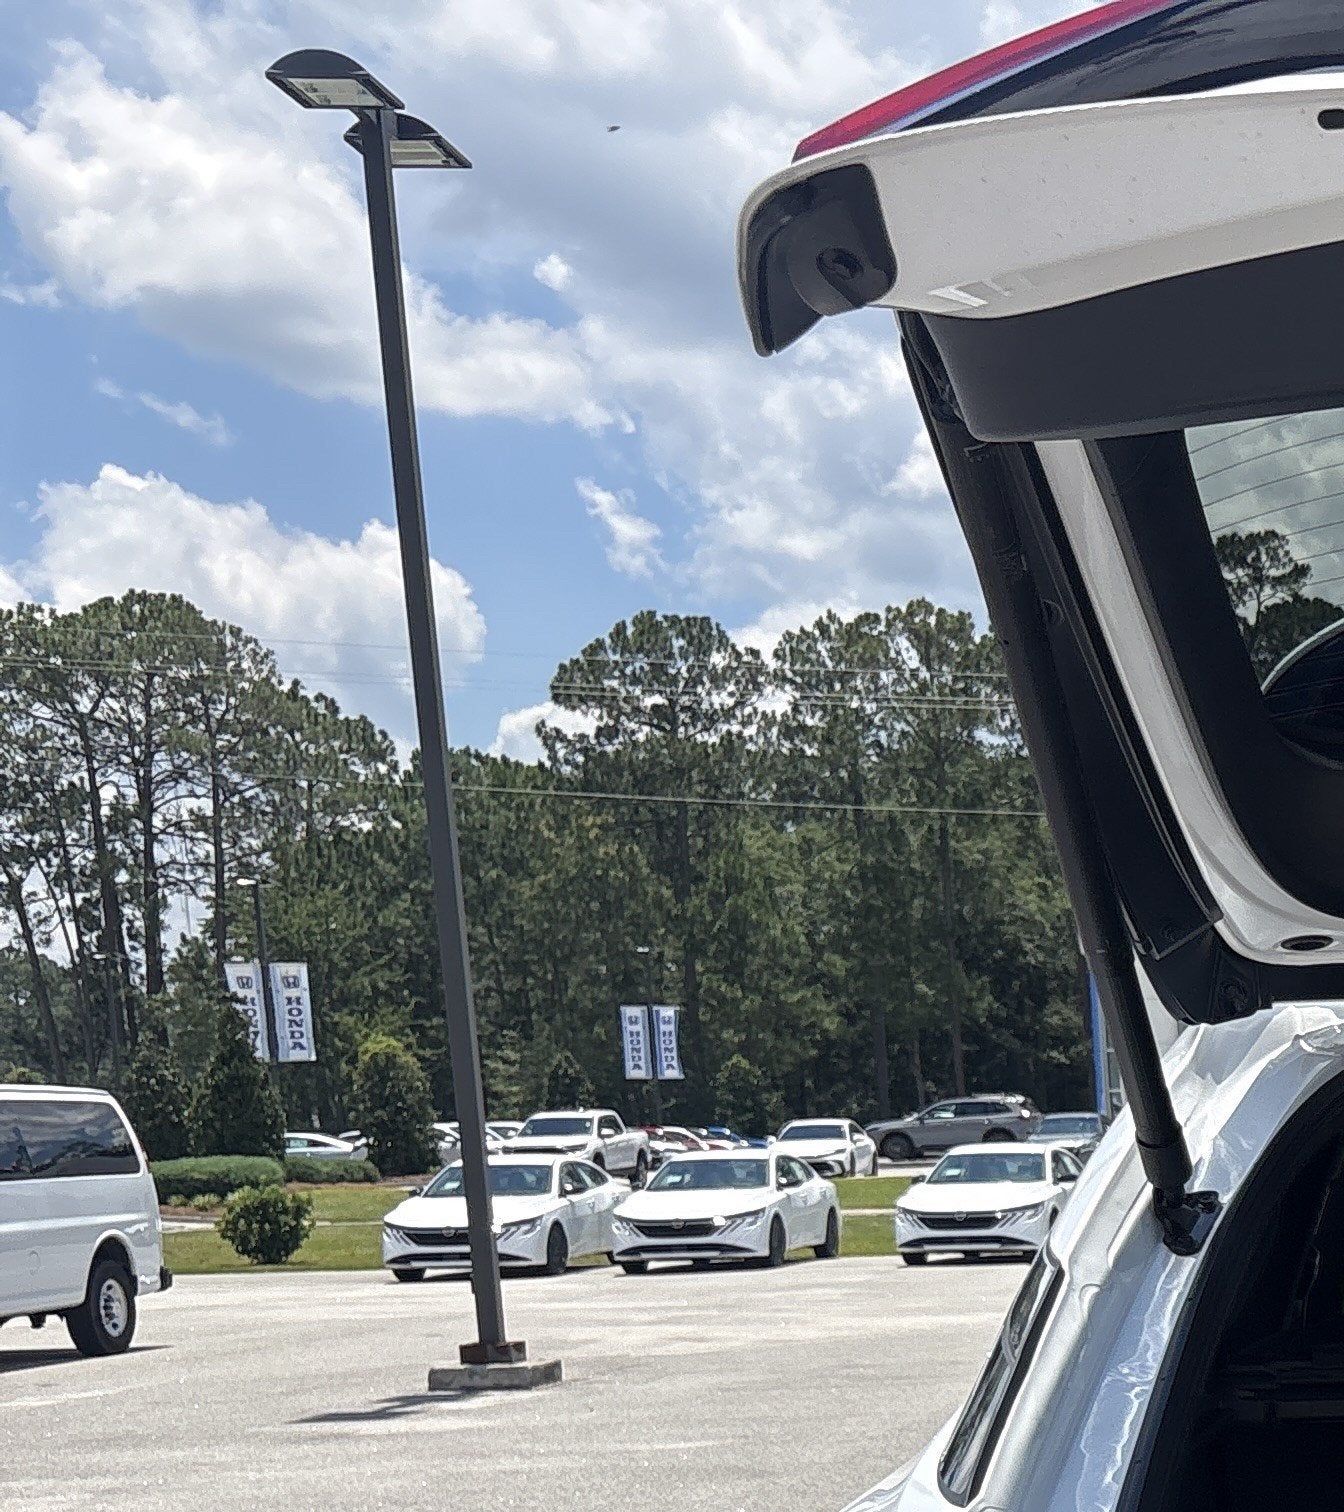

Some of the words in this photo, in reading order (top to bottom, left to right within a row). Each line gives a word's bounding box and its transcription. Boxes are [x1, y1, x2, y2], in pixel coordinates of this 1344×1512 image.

[284, 996, 307, 1051] HONDA
[629, 1030, 643, 1071] HONDA
[662, 1030, 676, 1071] HONDA
